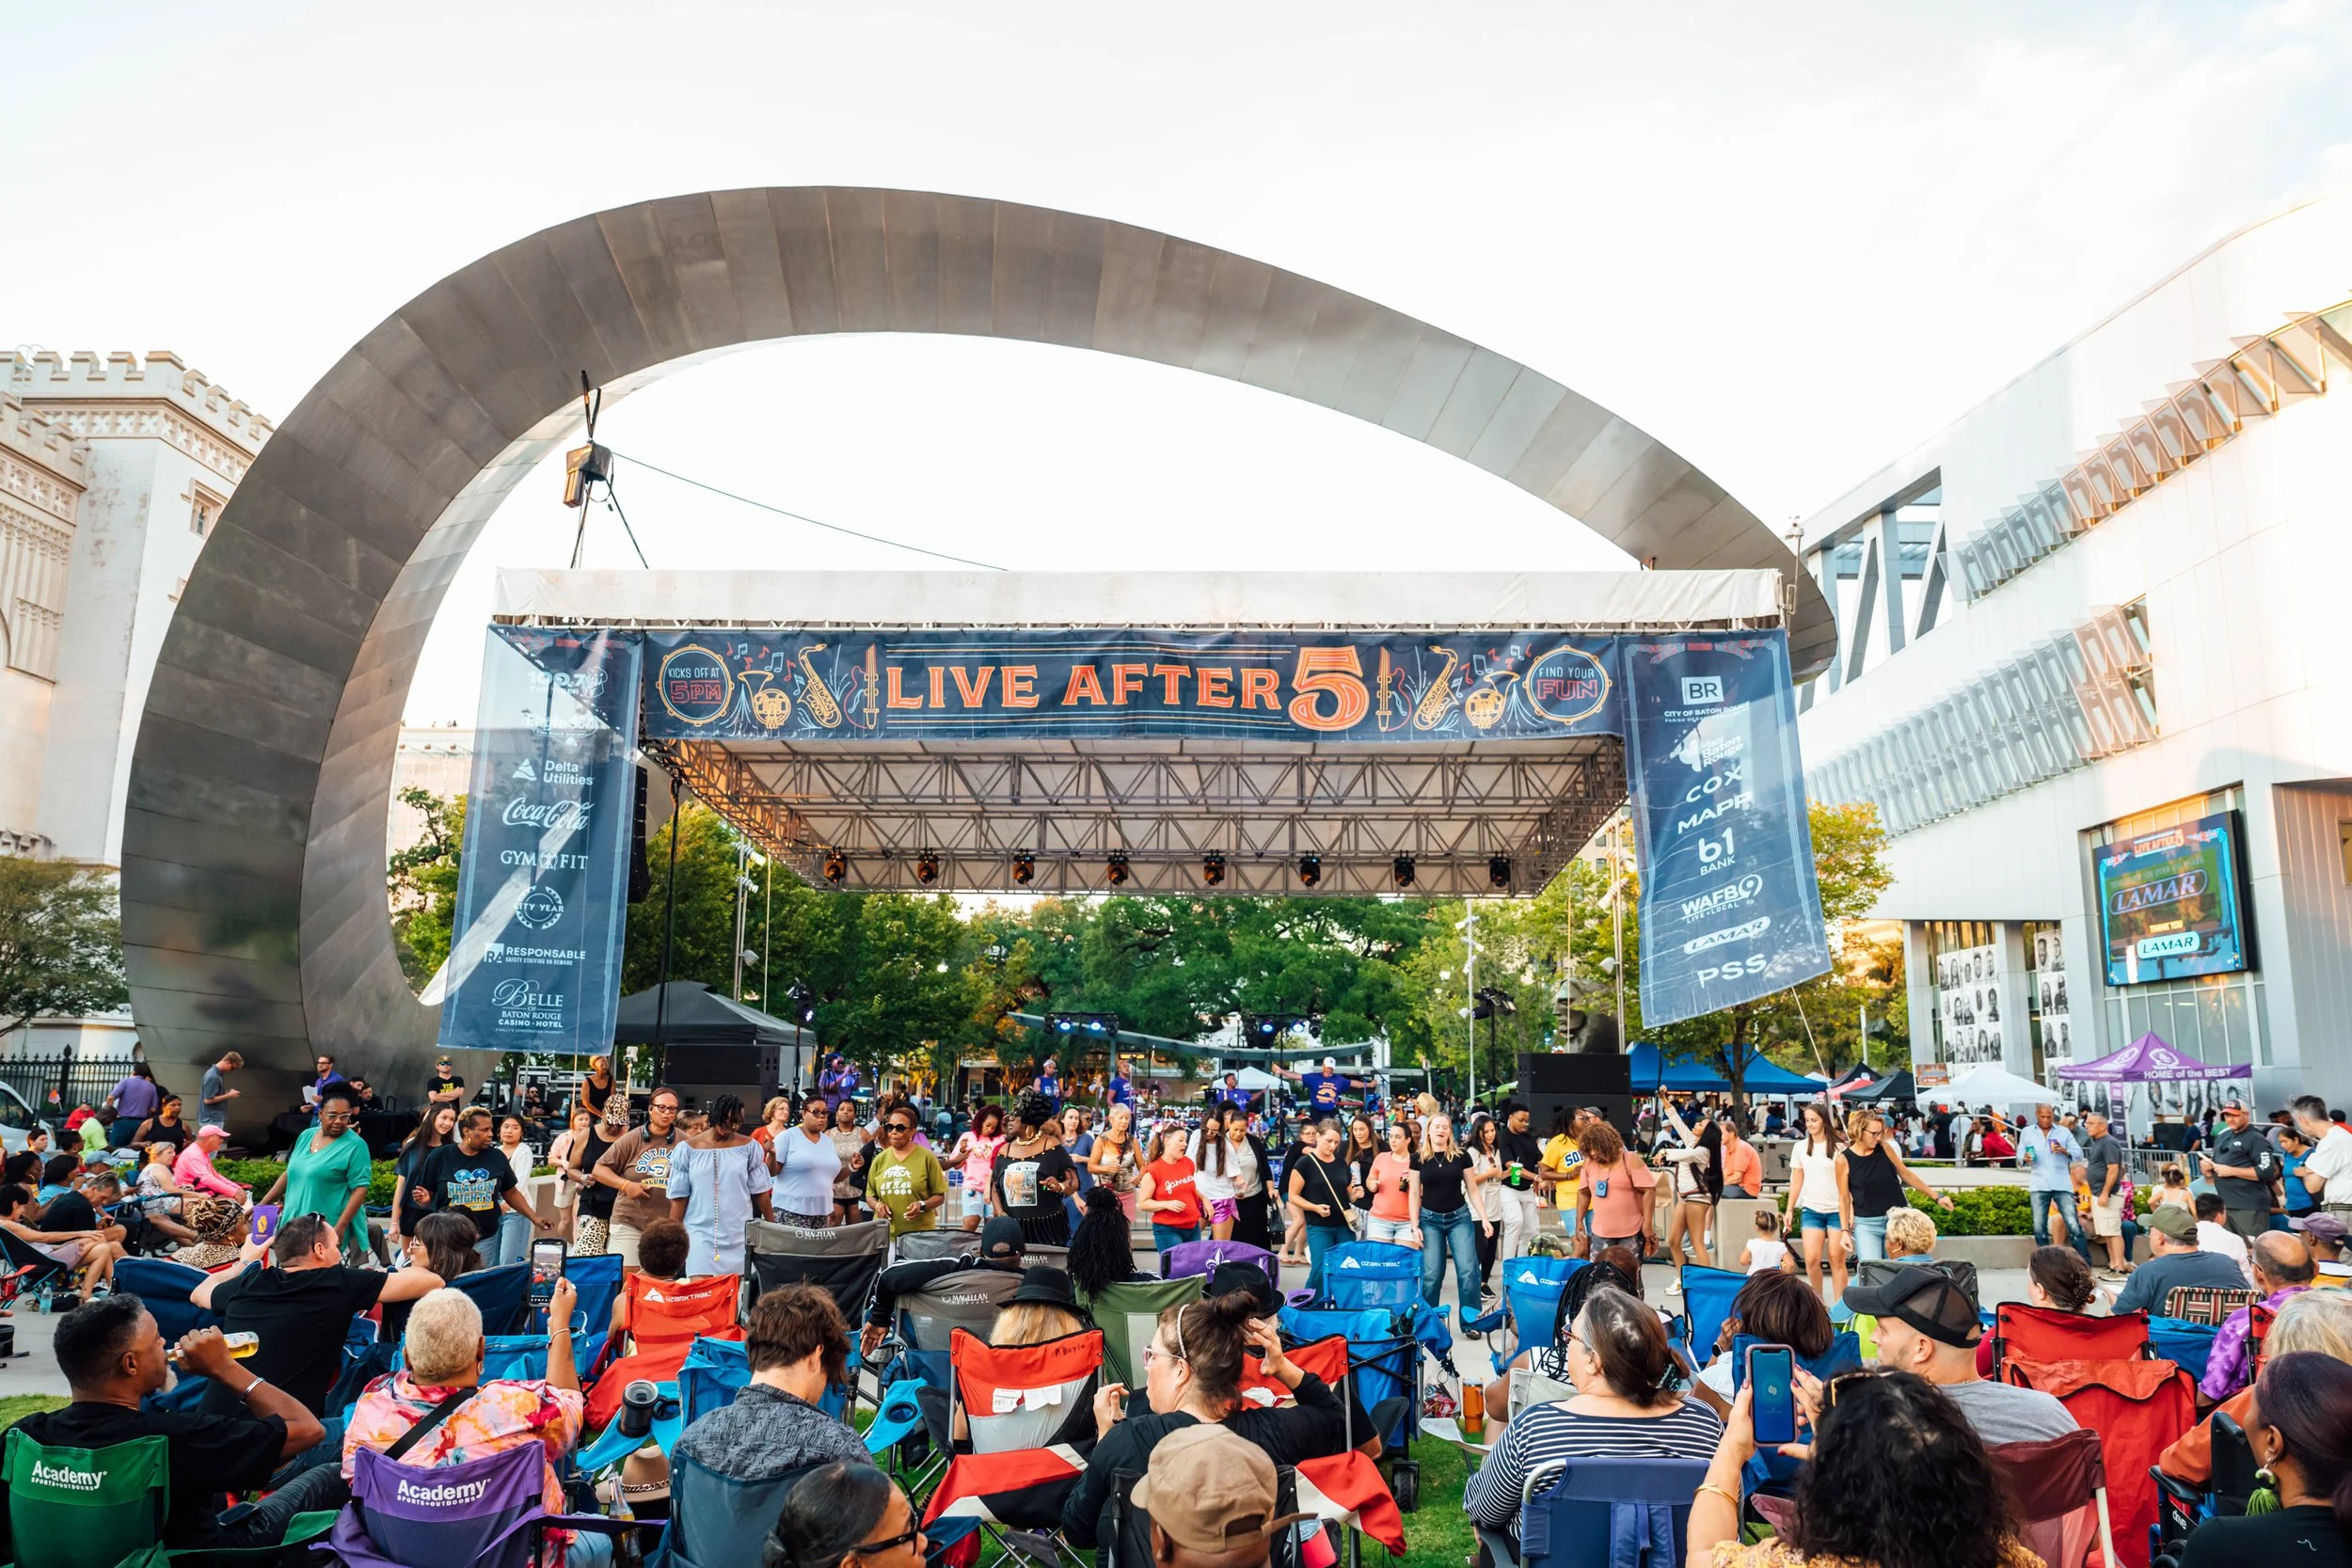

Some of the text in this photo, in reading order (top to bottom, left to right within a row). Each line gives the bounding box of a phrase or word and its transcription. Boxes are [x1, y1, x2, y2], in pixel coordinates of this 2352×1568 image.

[668, 667, 720, 678] KICKS OFF AT
[1539, 667, 1595, 678] FIND YOUR
[670, 680, 722, 704] 5PM
[886, 645, 1370, 732] LIVE AFTER 5
[1537, 679, 1597, 701] FUN
[1689, 682, 1718, 699] BR
[1694, 707, 1722, 716] BATON
[1701, 736, 1724, 749] Visit
[1702, 736, 1741, 758] Baton
[1703, 743, 1743, 768] Rouge
[545, 760, 579, 772] Delta
[543, 773, 594, 785] Utilities
[1686, 766, 1744, 803] COX
[502, 797, 595, 831] Coca-Cola
[1678, 790, 1754, 835] MAPP
[1698, 828, 1735, 863] b1
[2134, 842, 2152, 855] LIVE
[2152, 836, 2175, 850] AFTER
[501, 850, 588, 869] GYM FIT
[1700, 854, 1736, 876] BANK
[2117, 874, 2196, 911] LAMAR
[515, 902, 564, 912] CITY YEAR
[1692, 922, 1764, 950] LAMAR
[2142, 936, 2193, 954] LAMAR
[506, 946, 586, 959] RESPONSABLE
[1697, 953, 1768, 989] PSS
[492, 978, 564, 1007] BELLE
[501, 1010, 562, 1021] BATON ROUGE
[2144, 1069, 2173, 1079] HOME
[2175, 1069, 2185, 1078] of
[2204, 1068, 2232, 1077] BEST
[452, 1192, 492, 1204] RIGHTS
[690, 1291, 712, 1300] TRAIL
[952, 1292, 988, 1302] MAGELLAN
[31, 1460, 103, 1489] Academy
[397, 1479, 487, 1501] Academy
